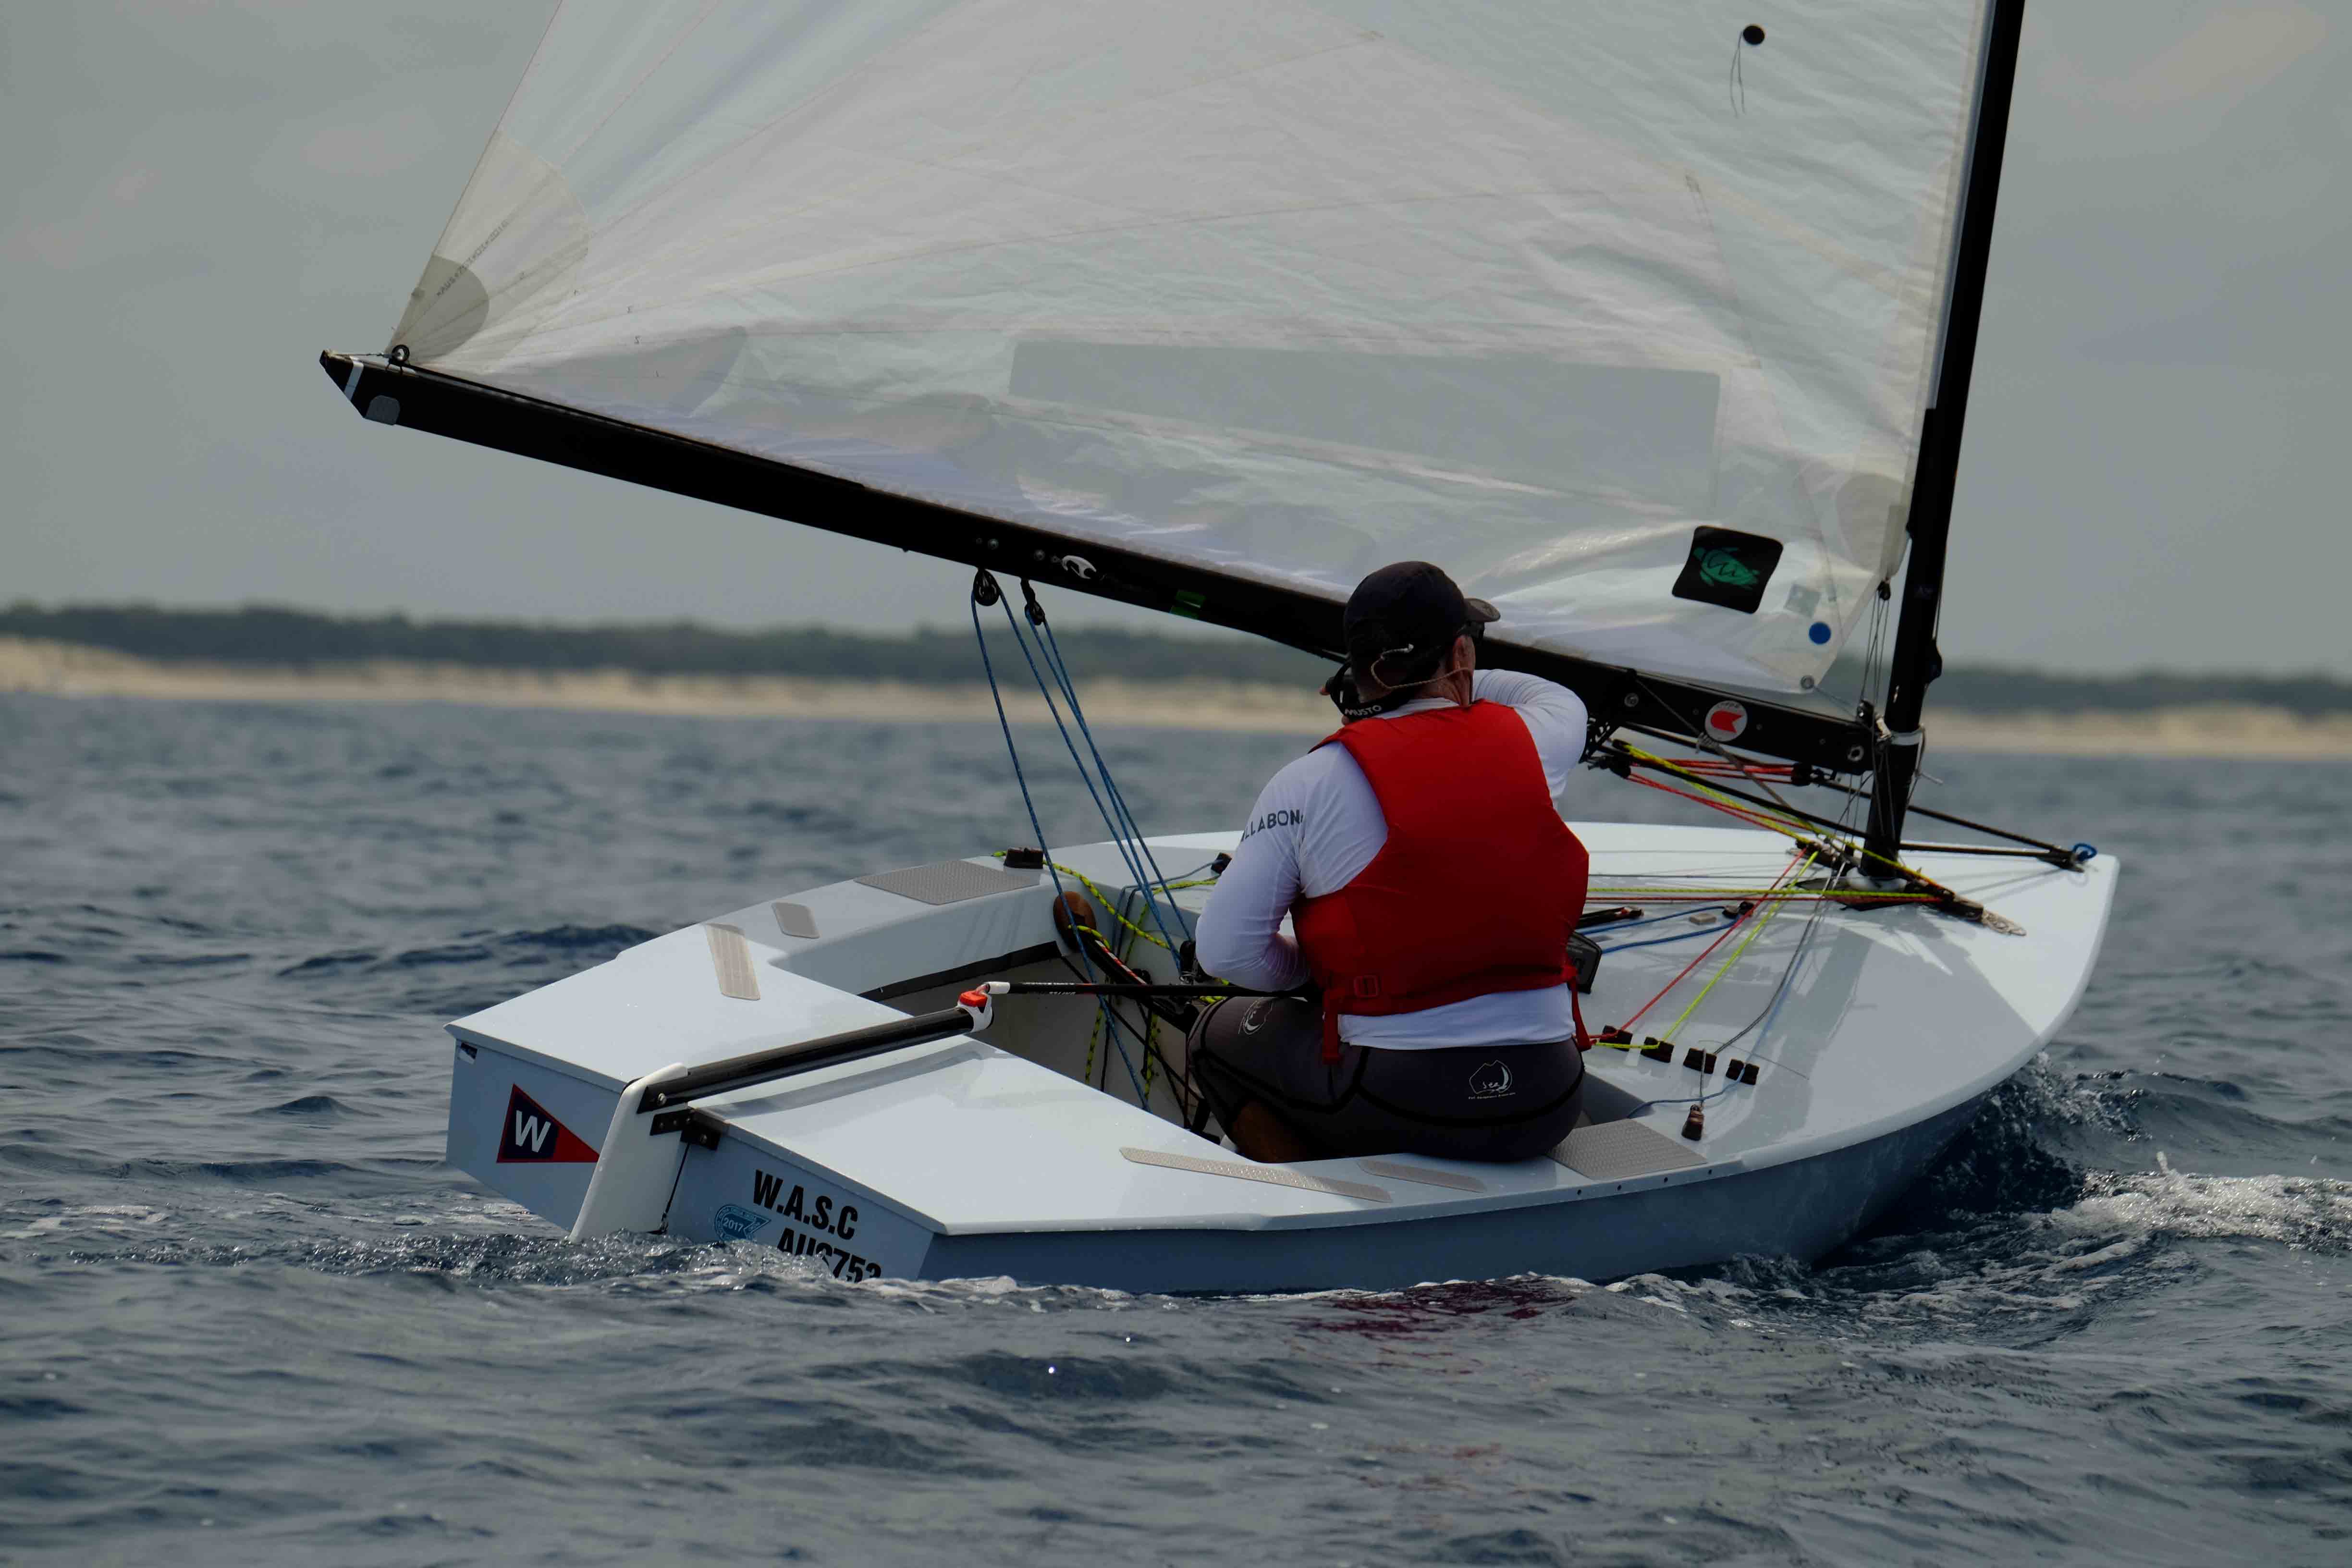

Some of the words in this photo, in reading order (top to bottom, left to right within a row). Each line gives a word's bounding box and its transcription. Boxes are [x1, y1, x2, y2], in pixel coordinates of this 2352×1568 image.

[1345, 705, 1382, 715] MUSTO
[1241, 809, 1303, 842] ILLABON
[515, 1110, 551, 1152] W
[753, 1169, 858, 1240] W.A.S.C
[723, 1217, 744, 1232] 2017
